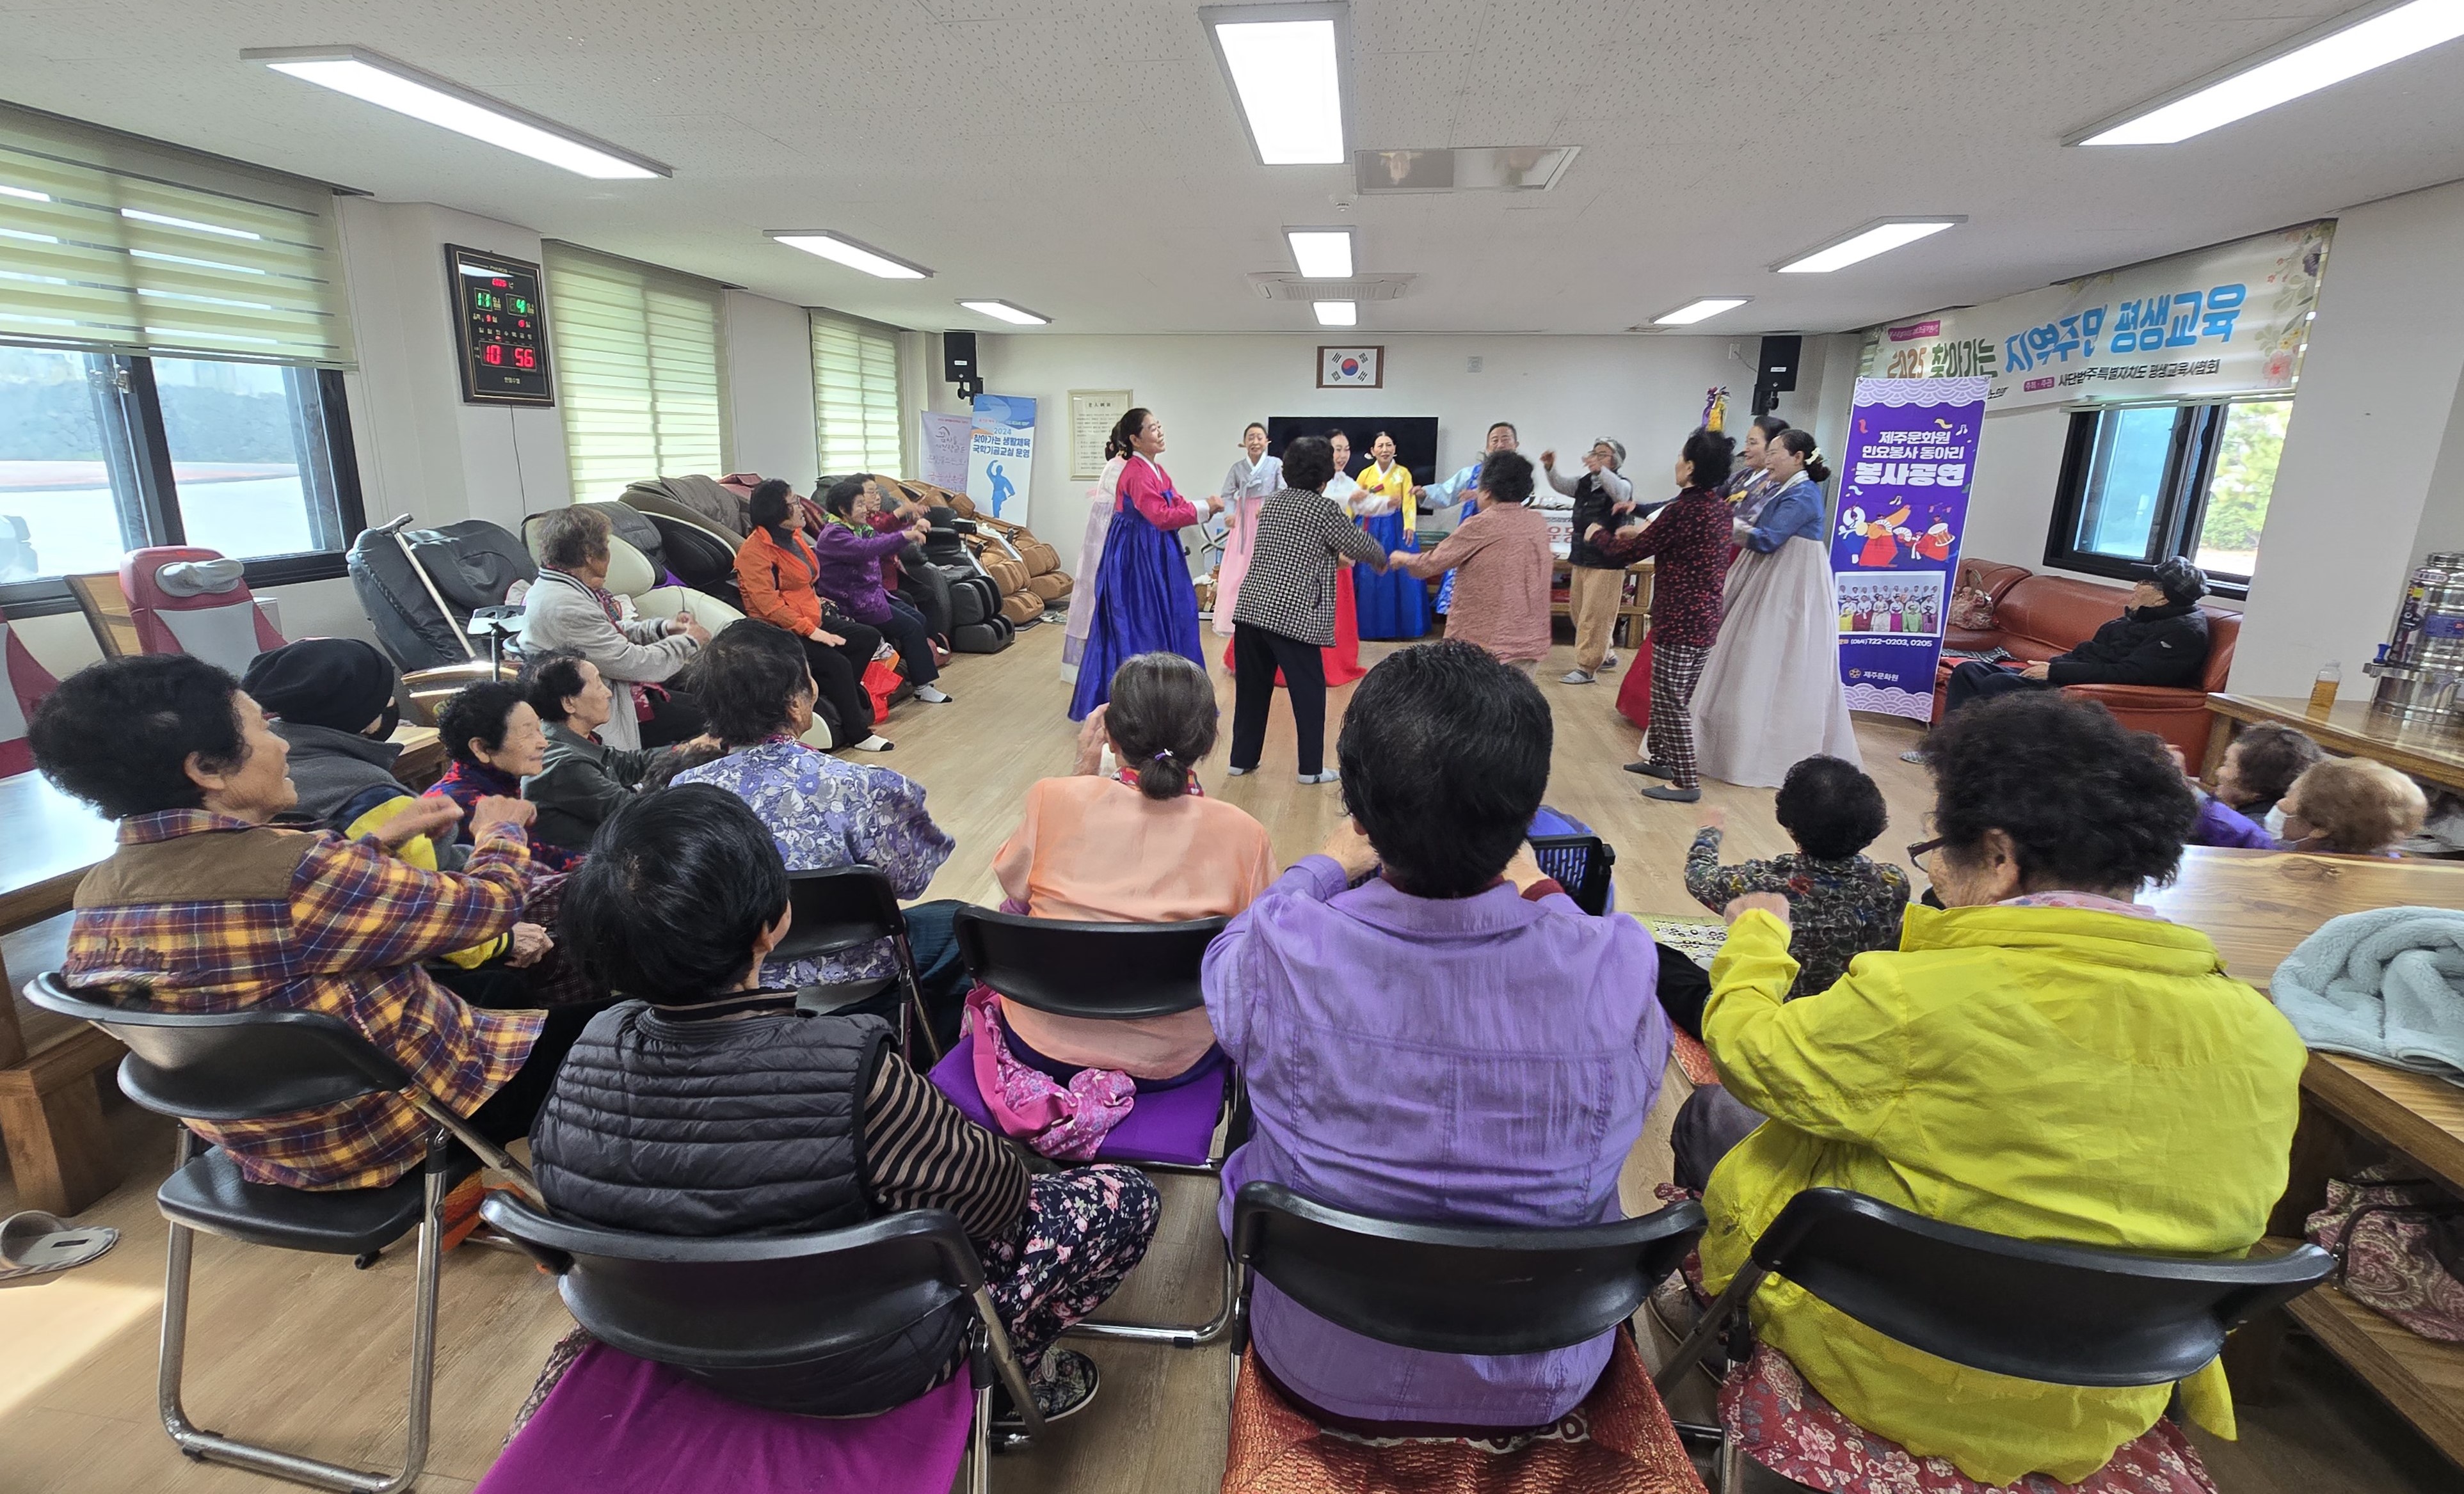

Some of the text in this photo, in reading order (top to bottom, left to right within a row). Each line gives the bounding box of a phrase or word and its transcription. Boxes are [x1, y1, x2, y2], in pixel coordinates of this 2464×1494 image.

[477, 292, 491, 308] 11
[516, 299, 526, 314] 4
[2111, 283, 2247, 353] 평생교육
[486, 345, 535, 368] 10 56
[1928, 338, 1998, 379] 찾아가는
[973, 434, 1030, 447] 찾아가는 생활체육
[1878, 431, 1951, 445] 제주문화원
[1016, 448, 1030, 458] 운영
[1862, 445, 1964, 459] 민요봉사 동아리
[1854, 462, 1966, 486] 봉사공연
[1910, 639, 1933, 648] 0205
[1863, 671, 1900, 681] 제주문화원
